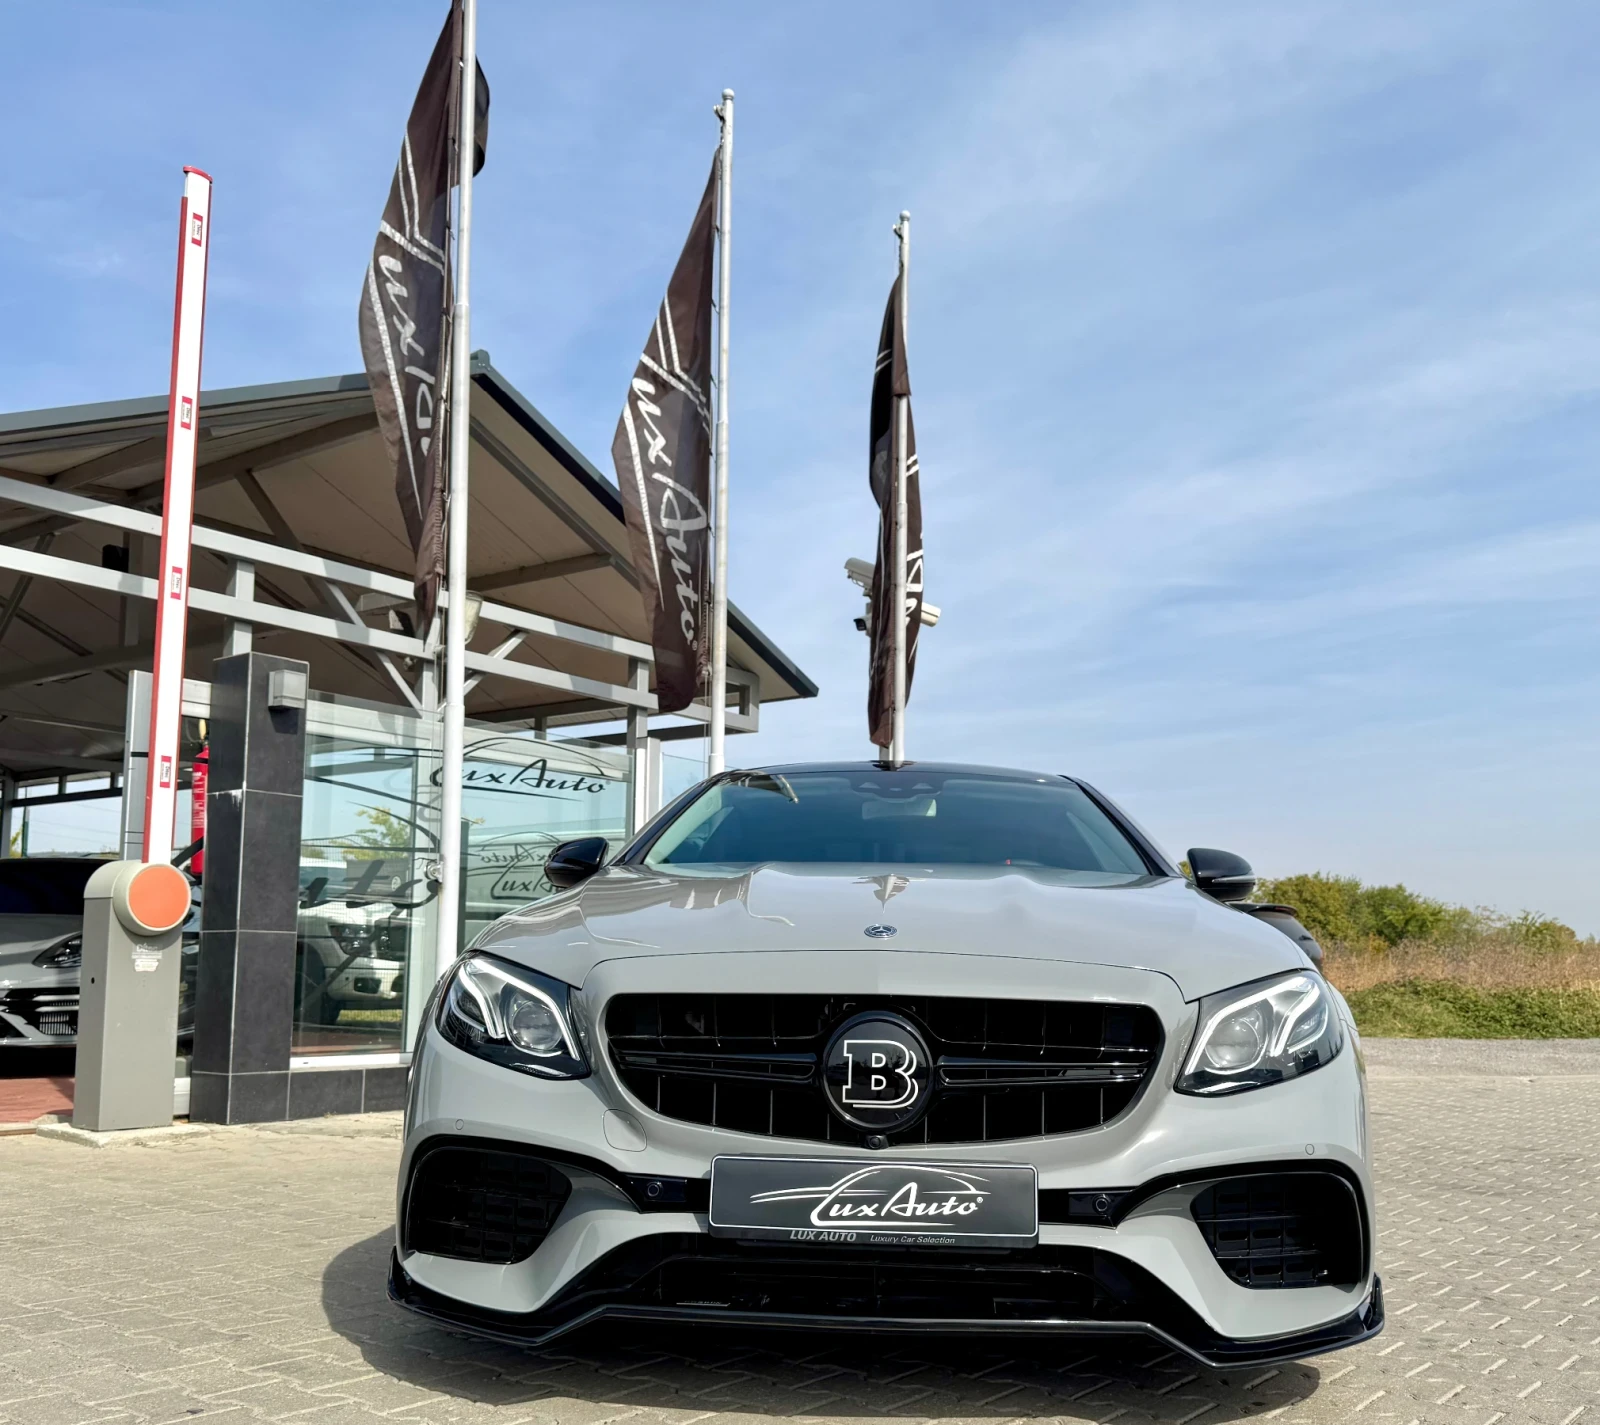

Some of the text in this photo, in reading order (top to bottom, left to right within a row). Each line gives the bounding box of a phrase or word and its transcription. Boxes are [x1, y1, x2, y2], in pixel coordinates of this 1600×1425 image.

[842, 1039, 919, 1109] B
[789, 1229, 857, 1242] LUX AUTO
[870, 1234, 899, 1244] Luxury
[900, 1235, 915, 1243] Car
